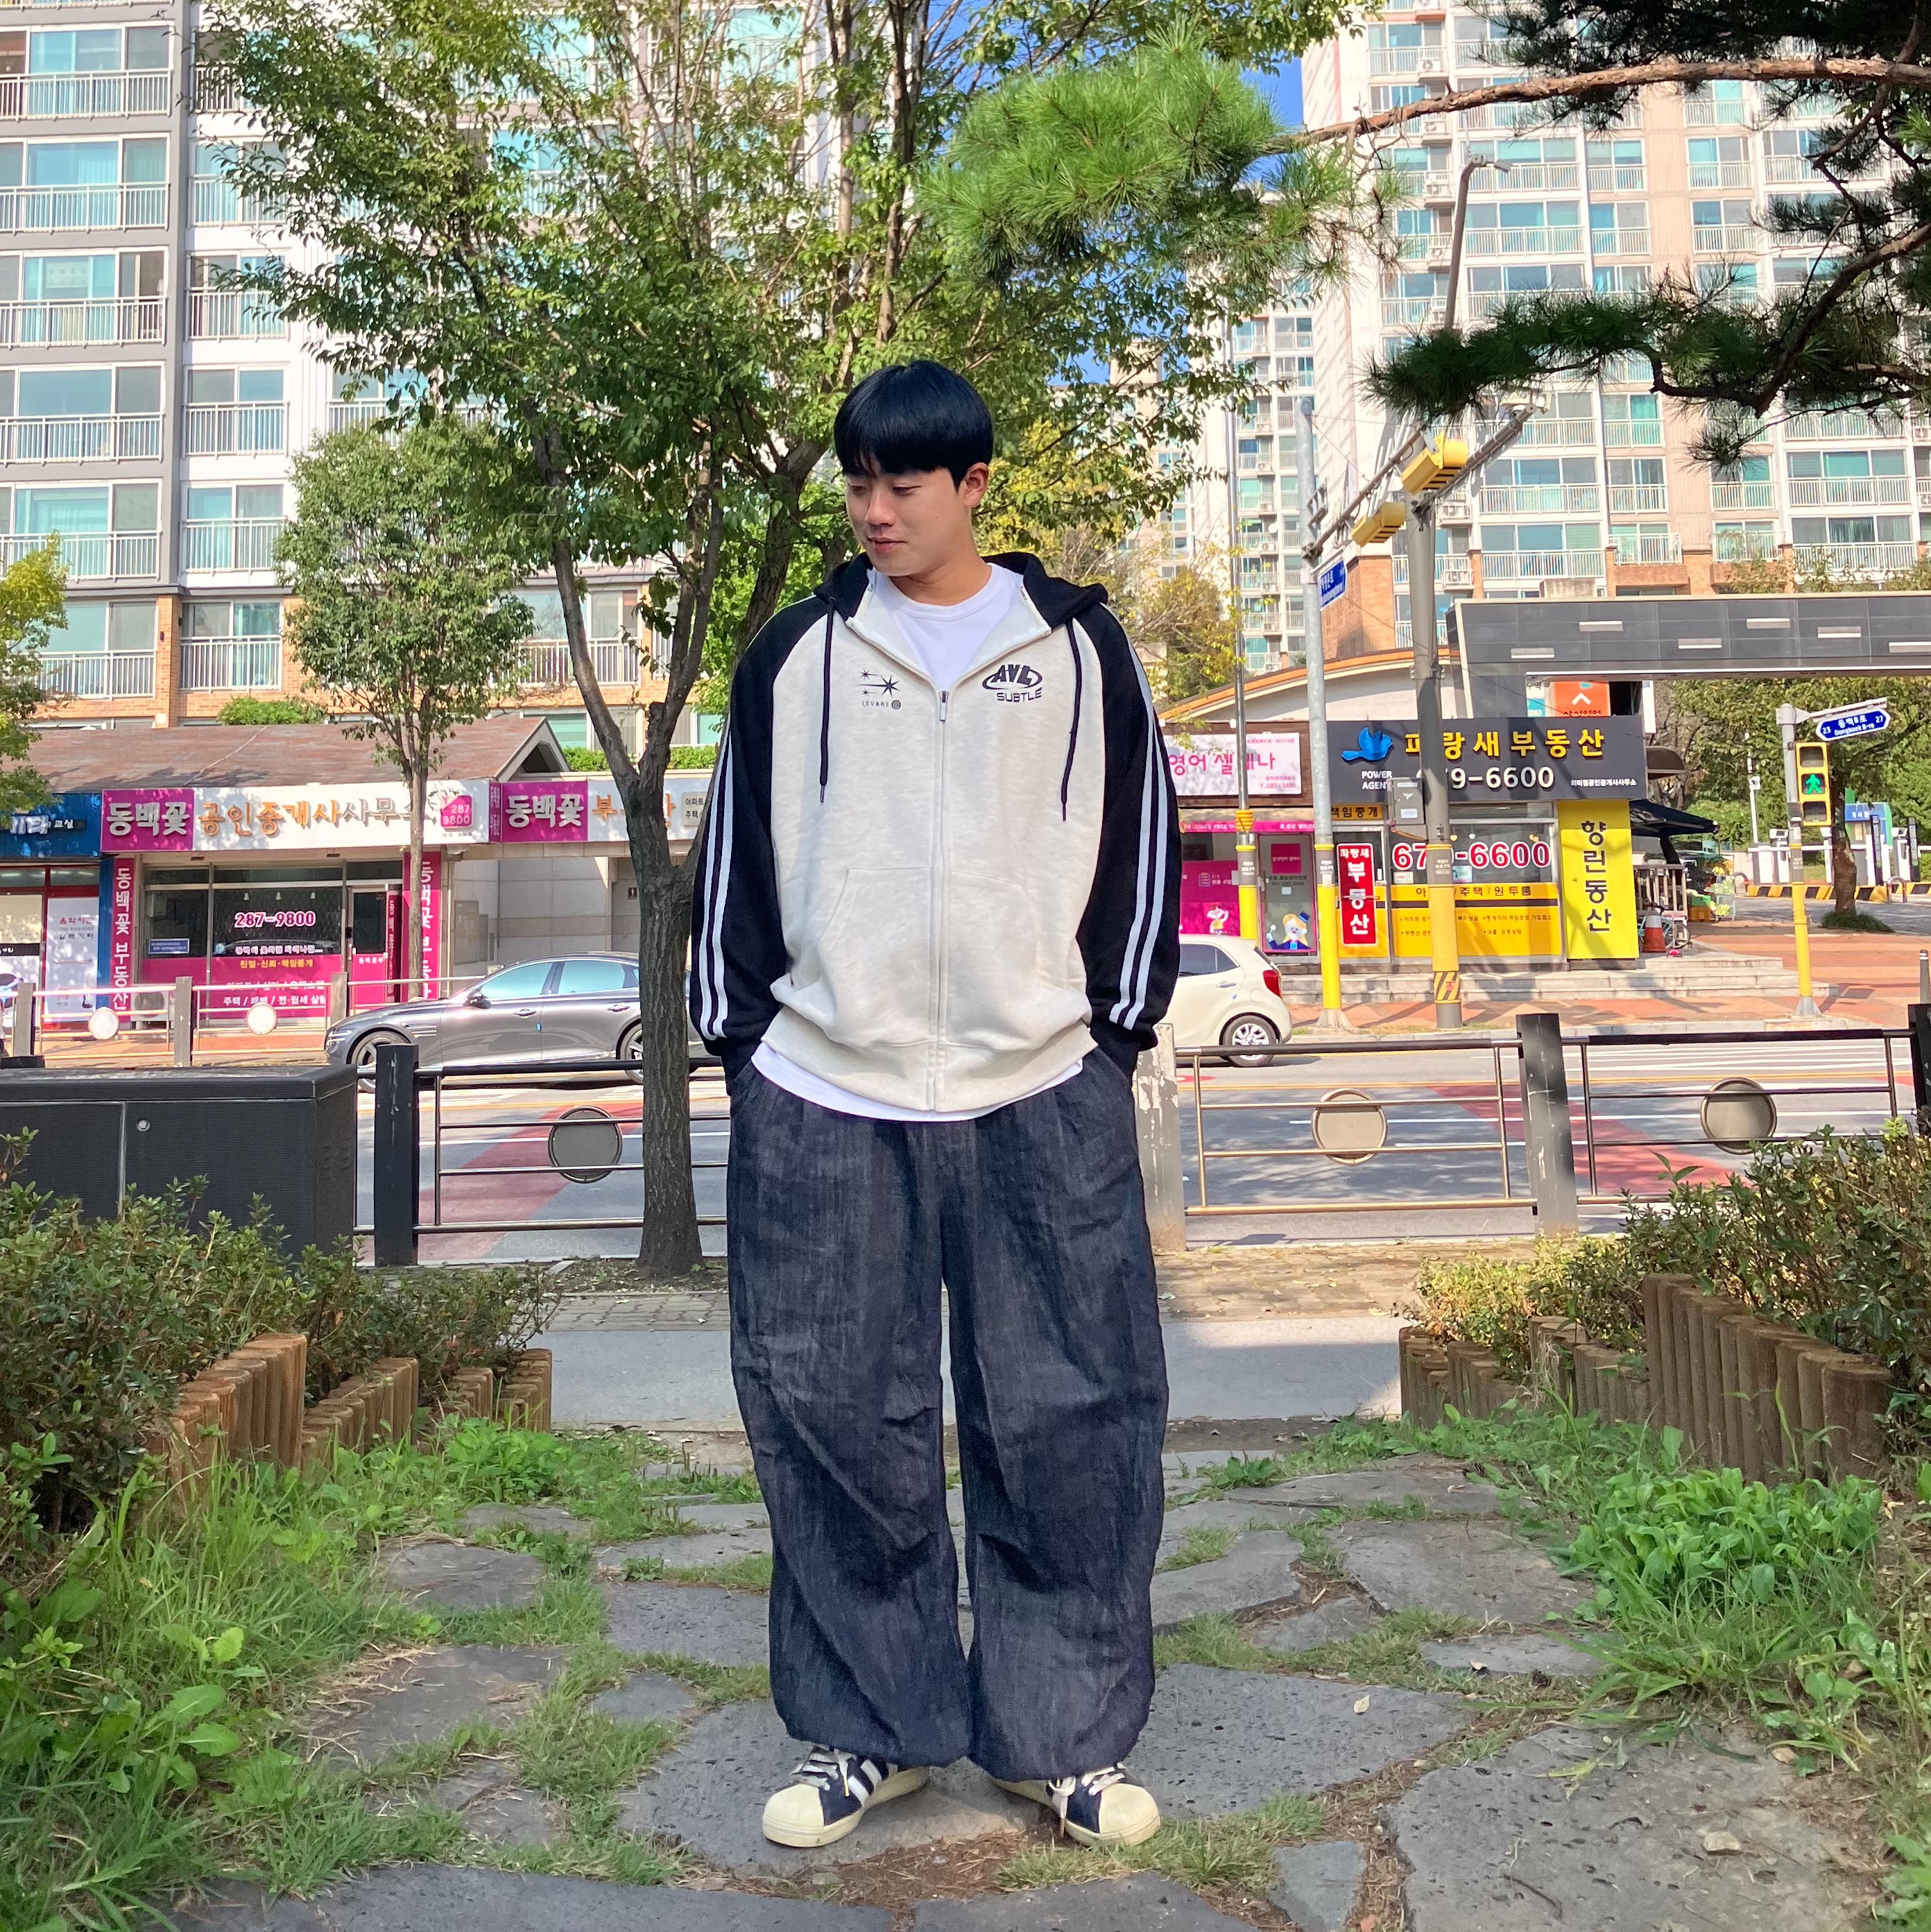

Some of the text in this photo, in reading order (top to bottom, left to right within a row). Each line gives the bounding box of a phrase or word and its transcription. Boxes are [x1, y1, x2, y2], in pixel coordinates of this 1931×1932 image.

[990, 664, 1032, 686] AVL
[997, 687, 1042, 703] SUBTLE
[1362, 770, 1393, 780] POWER
[105, 801, 191, 836] 동백꽃
[451, 804, 470, 814] 287
[505, 794, 585, 828] 동백꽃
[443, 815, 470, 826] 9800
[1339, 848, 1370, 859] 파랑새
[1391, 841, 1552, 871] 67-6600
[1581, 820, 1613, 932] 향린동산
[234, 910, 316, 928] 287-9800
[112, 867, 132, 1010] 동백꽃 부동산
